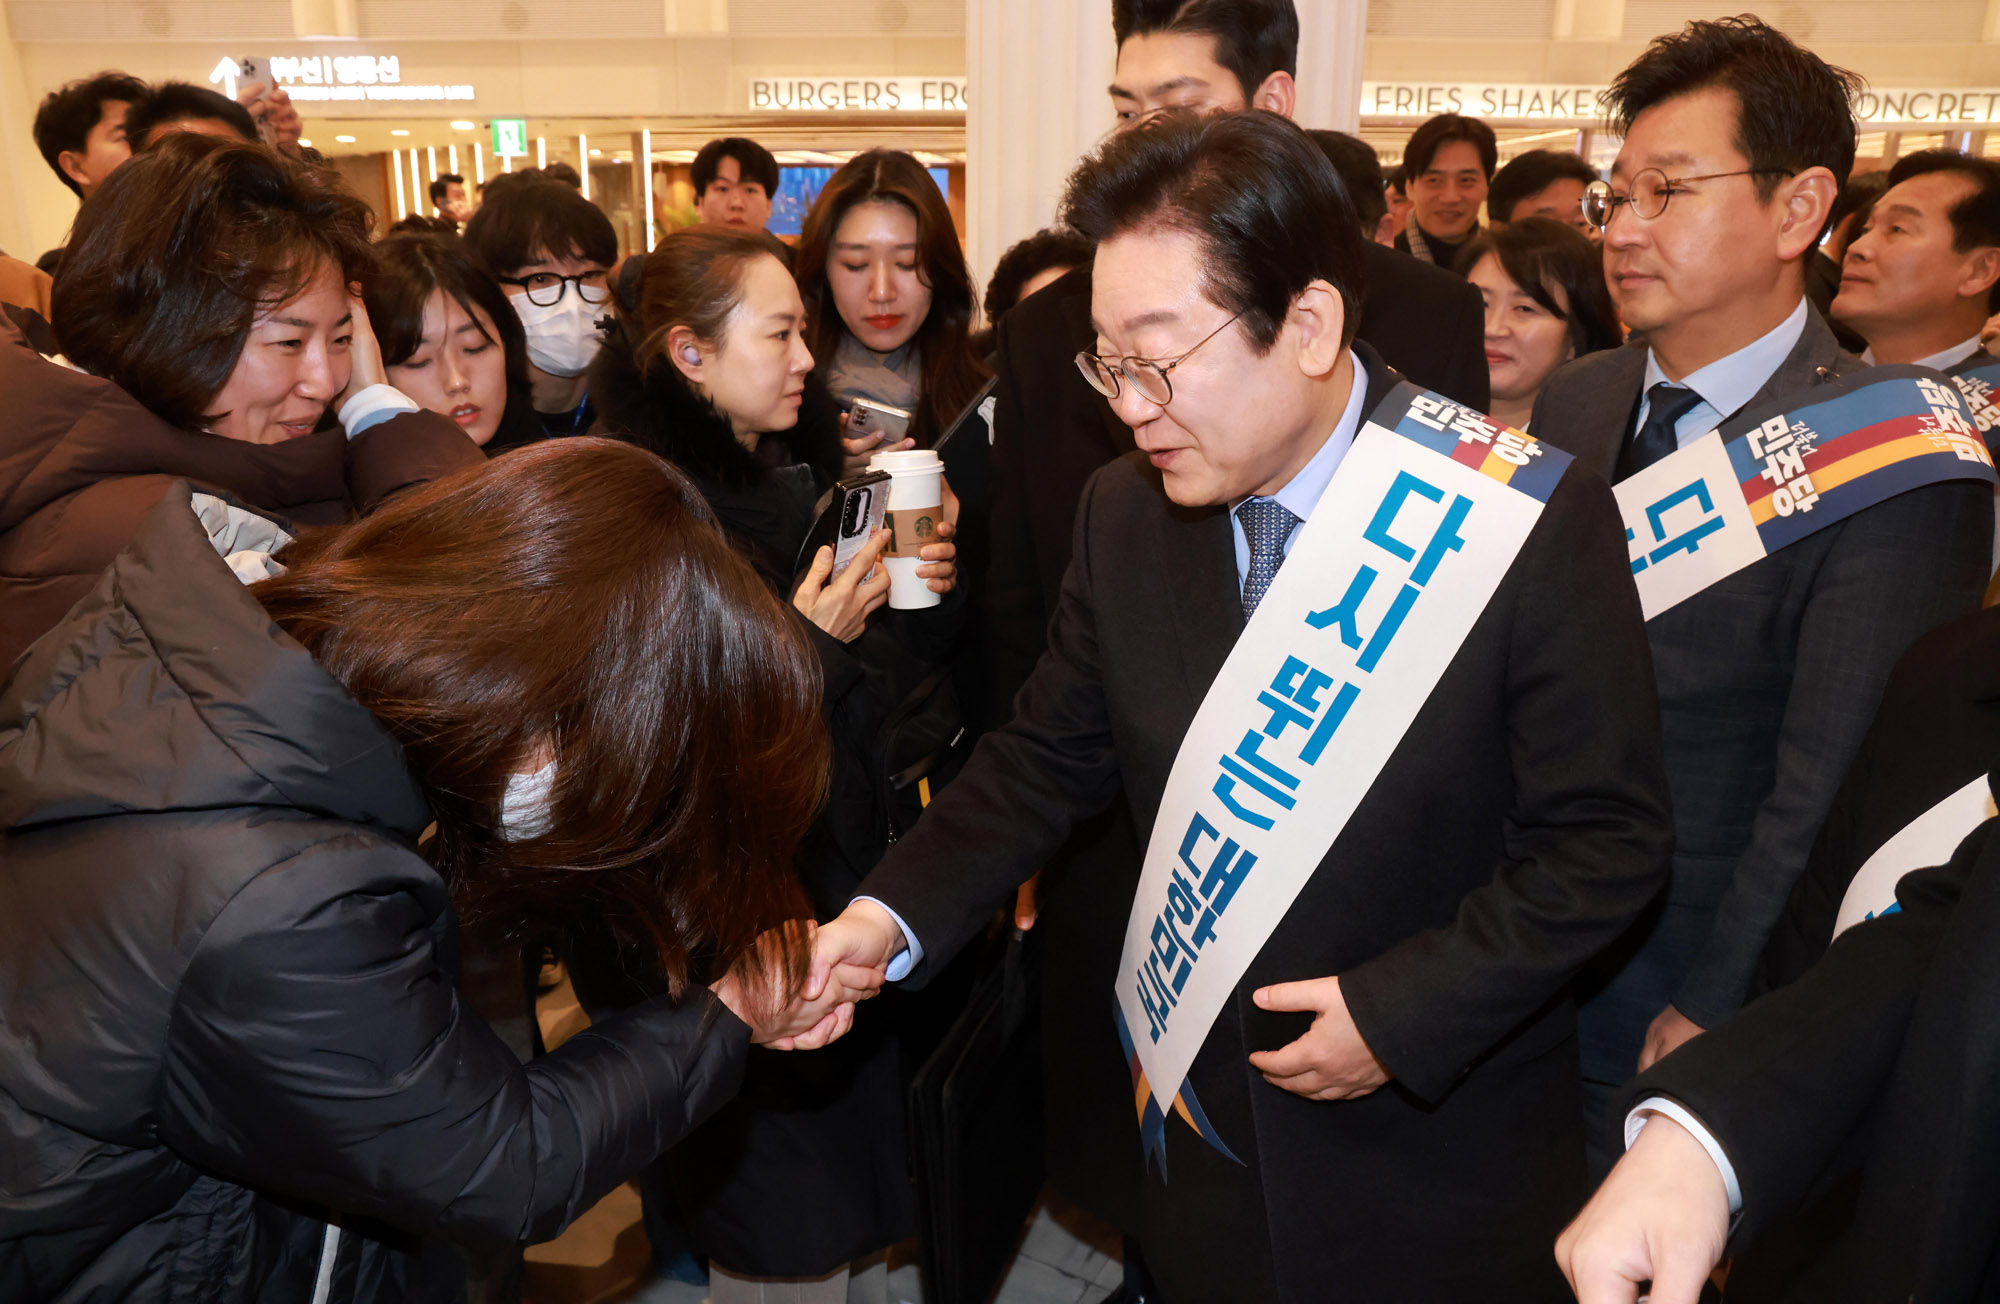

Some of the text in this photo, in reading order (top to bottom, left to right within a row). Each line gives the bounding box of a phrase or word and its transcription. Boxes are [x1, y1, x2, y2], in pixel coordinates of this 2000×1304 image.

[753, 81, 967, 109] BURGERS FR
[1375, 86, 2000, 120] FRIES SHAKES ONCRET
[1405, 394, 1543, 466] 민주당
[1790, 420, 1819, 458] 더불어
[1915, 377, 1992, 468] 민주당
[1745, 414, 1820, 517] 민주당
[1626, 477, 1726, 574] 다
[1136, 469, 1474, 1045] 다시 뛰는 대한민국
